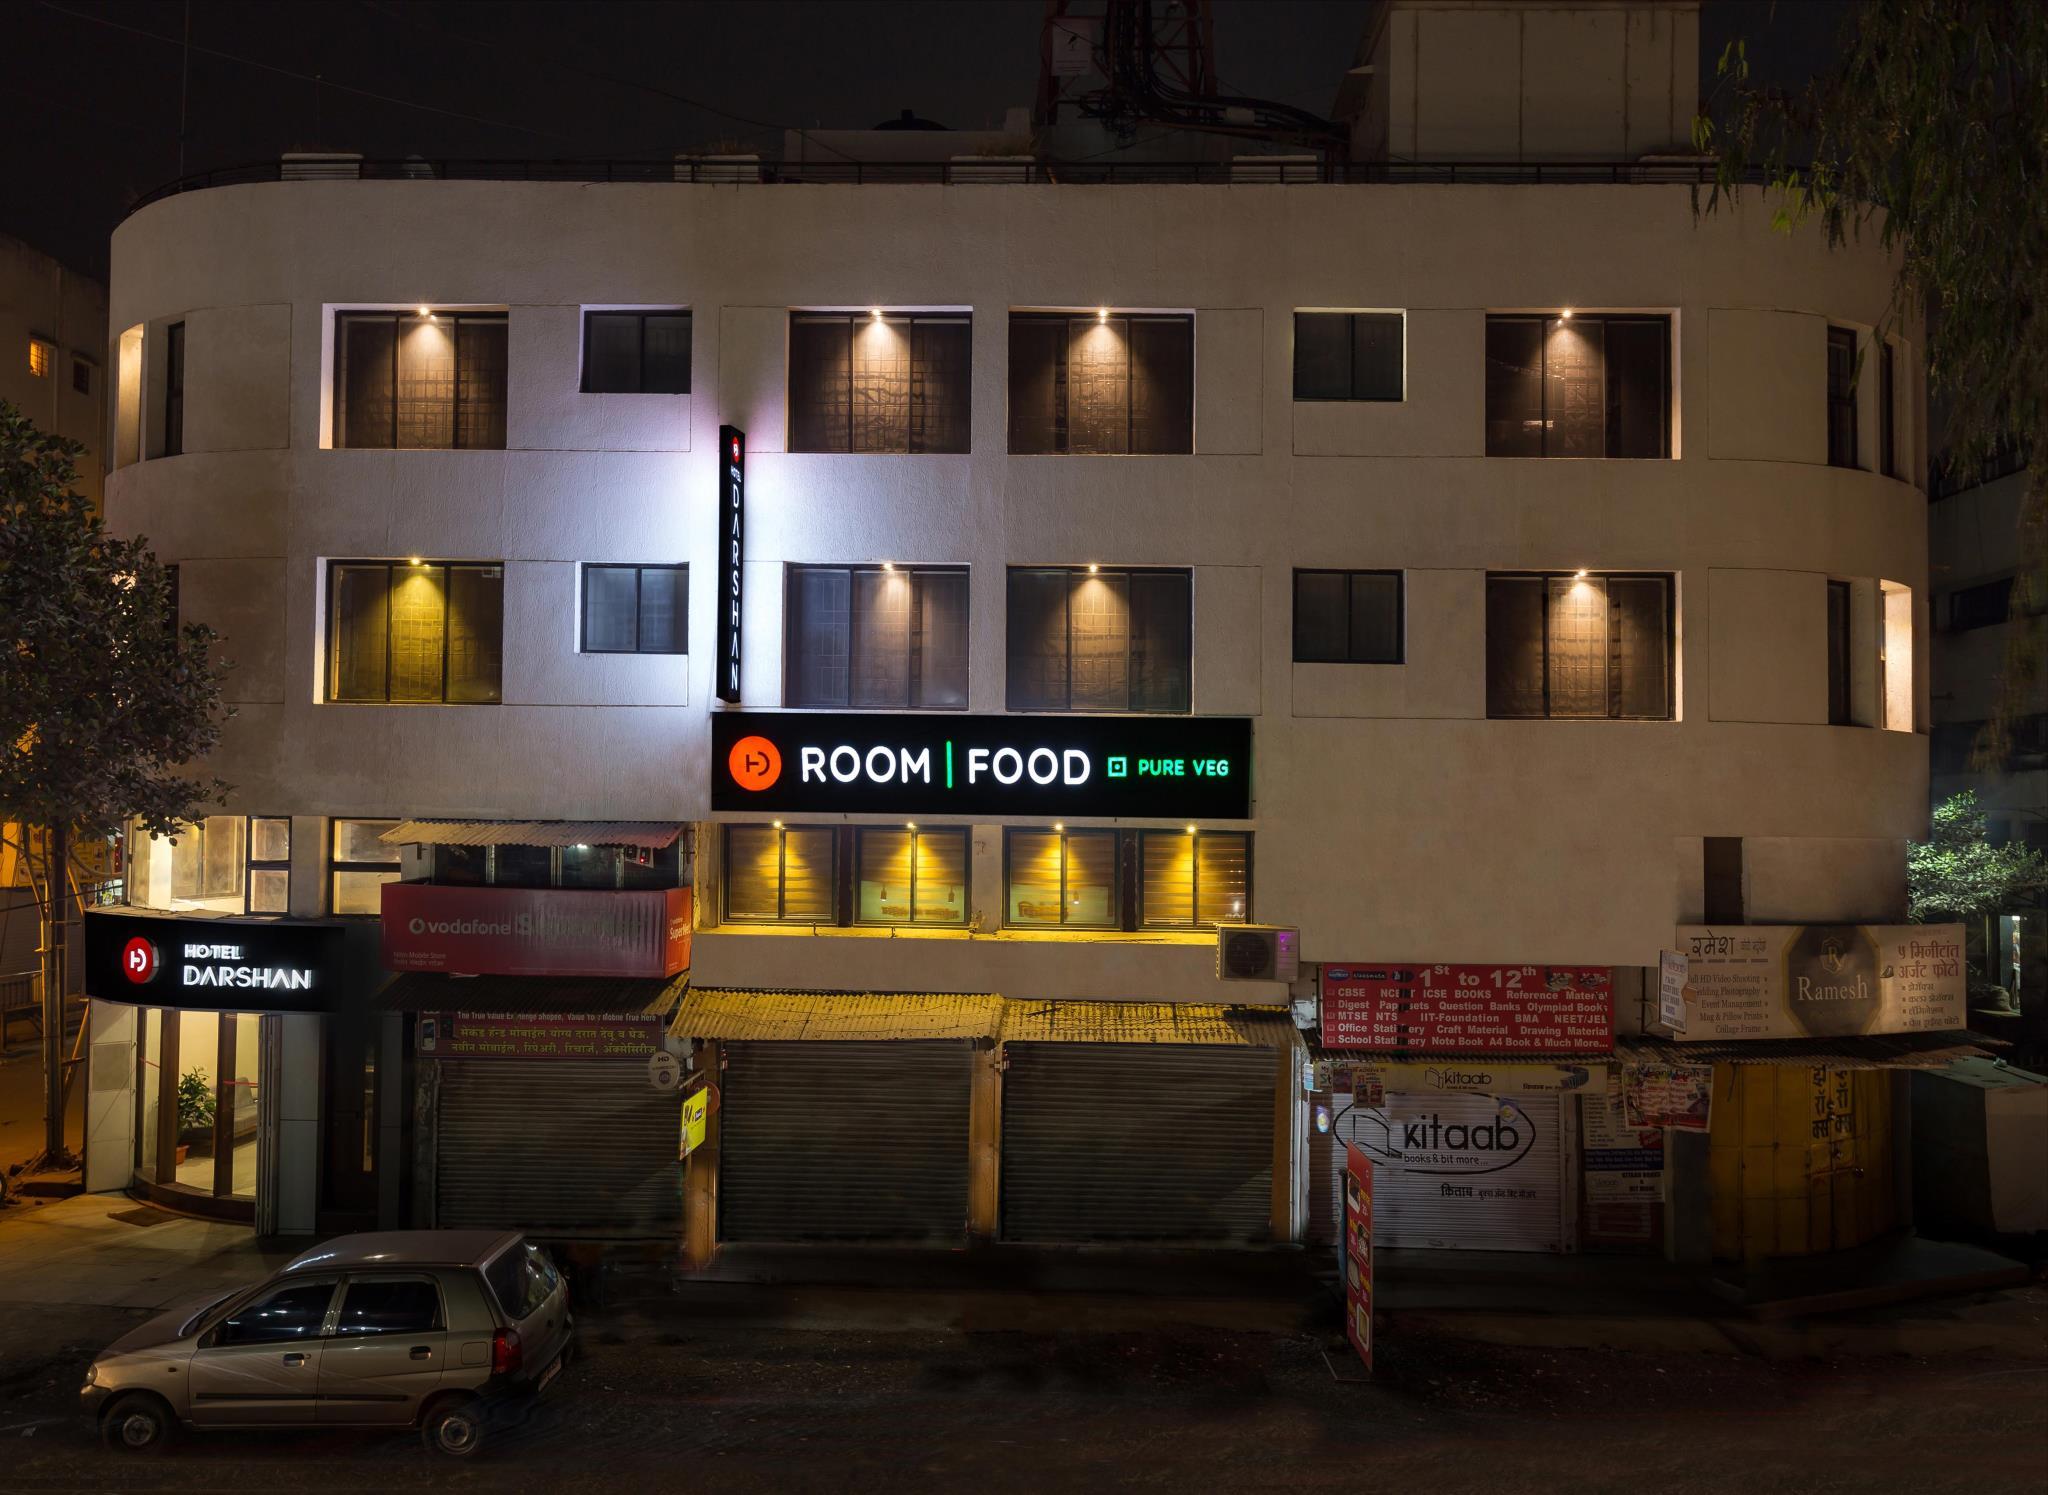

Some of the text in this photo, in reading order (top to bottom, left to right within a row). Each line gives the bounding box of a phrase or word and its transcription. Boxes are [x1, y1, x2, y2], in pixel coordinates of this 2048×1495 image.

[731, 483, 740, 690] DARSHAN
[801, 745, 1229, 785] ROOM FOOD PURE VEG
[428, 918, 512, 936] vodafone
[184, 943, 243, 961] HOTEL
[1690, 929, 1735, 957] रमेश
[1897, 945, 1906, 960] ५
[183, 965, 313, 990] DARSHAN
[1458, 972, 1481, 986] to
[1490, 966, 1537, 988] 12th
[1933, 959, 1960, 979] फोटो
[1338, 988, 1366, 997] CBSE
[1380, 988, 1416, 998] NCET
[1423, 989, 1447, 998] ICSE
[1454, 990, 1492, 999] BOOKS
[1506, 990, 1558, 1000] Reference
[1797, 974, 1869, 1001] Ramesh
[1338, 1000, 1370, 1011] Digest
[1439, 1001, 1483, 1011] Question
[1490, 1002, 1520, 1011] Banks
[1527, 1003, 1573, 1013] Olympiad
[1338, 1012, 1368, 1021] MTSE
[1338, 1023, 1608, 1037] Office Statiery Craft Material Drawing Material
[1338, 1035, 1371, 1044] School
[1374, 1036, 1426, 1047] Statiery
[1431, 1036, 1456, 1046] Note
[1458, 1037, 1483, 1046] Book
[1489, 1037, 1502, 1046] A4
[1505, 1037, 1531, 1047] Book
[1534, 1038, 1542, 1047] &
[1545, 1038, 1571, 1048] Much
[1444, 1071, 1492, 1085] kitaab
[1404, 1114, 1519, 1151] kitaab
[1404, 1153, 1431, 1163] books
[1432, 1154, 1439, 1163] &
[1440, 1153, 1453, 1164] bit
[1441, 1183, 1473, 1197] किताब
